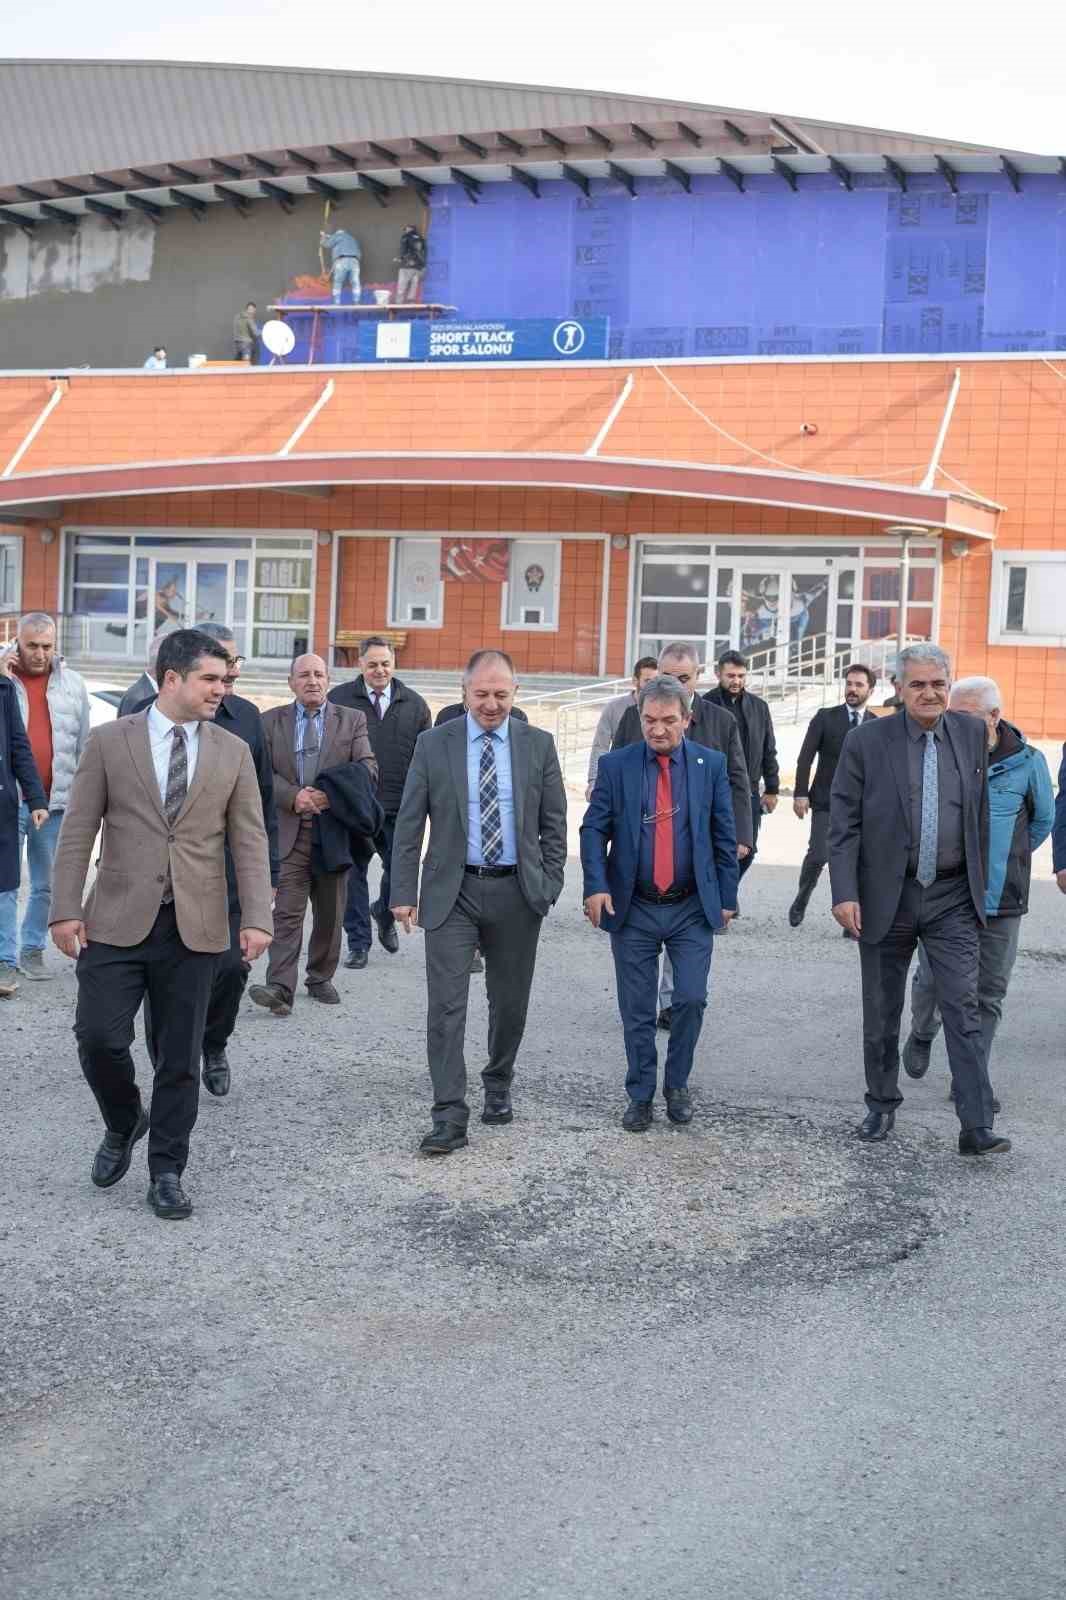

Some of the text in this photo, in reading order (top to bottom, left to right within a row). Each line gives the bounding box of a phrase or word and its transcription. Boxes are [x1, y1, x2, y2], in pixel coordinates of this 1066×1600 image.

[430, 331, 515, 344] SHORT TRACK
[429, 343, 512, 356] SPOR SALONU
